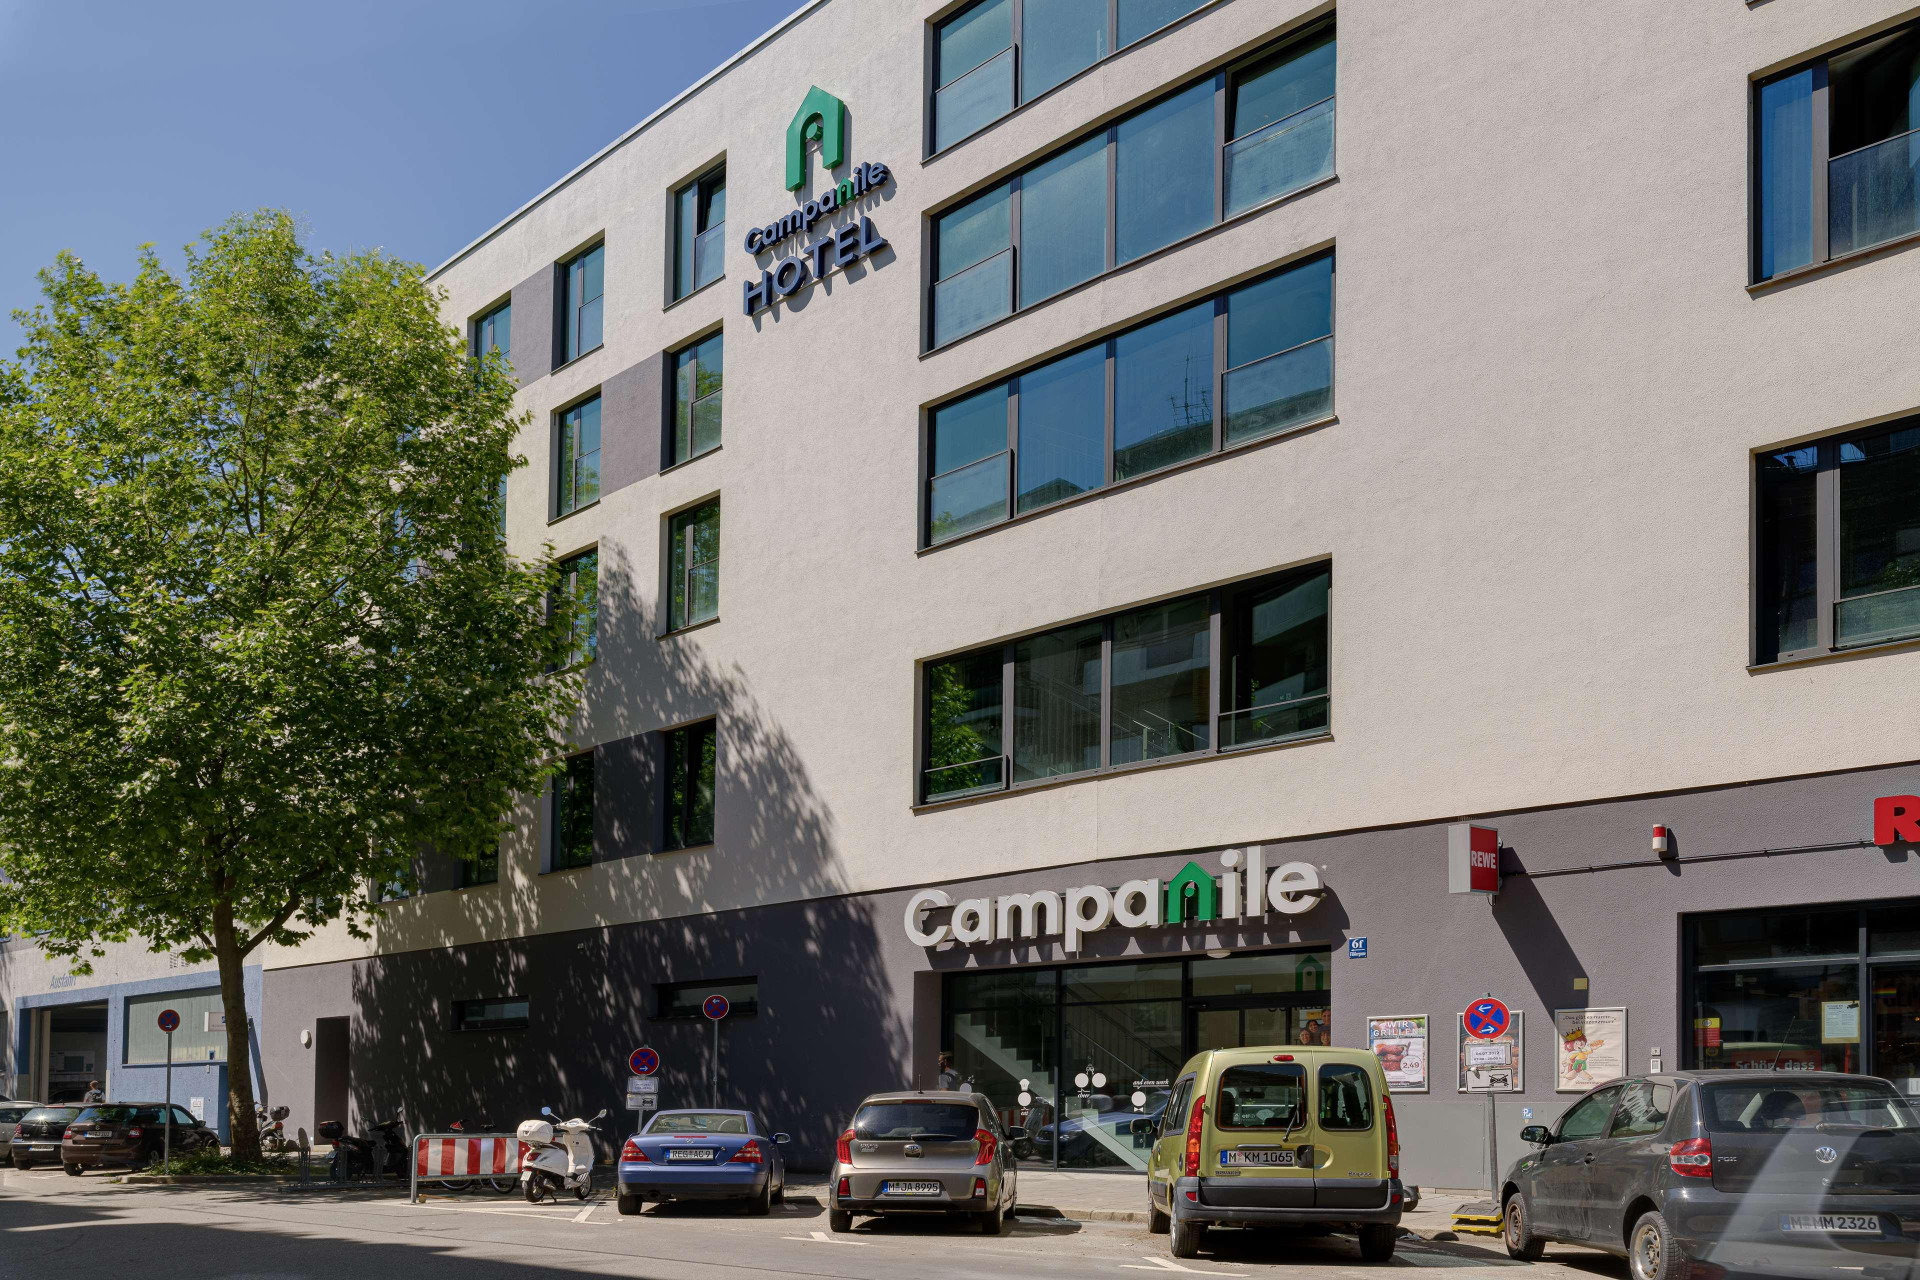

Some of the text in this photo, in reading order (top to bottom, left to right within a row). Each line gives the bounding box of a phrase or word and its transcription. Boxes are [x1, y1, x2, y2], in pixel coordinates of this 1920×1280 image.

[744, 161, 889, 255] Campanile
[743, 216, 888, 316] HOTEL
[1471, 850, 1496, 869] REWE
[903, 845, 1326, 953] Campanile
[1351, 938, 1365, 949] 6f
[1784, 1060, 1815, 1070] dass
[1228, 1152, 1293, 1162] M KM 1065
[888, 1182, 938, 1191] M JA 8995
[1812, 1216, 1835, 1229] MM
[1838, 1216, 1877, 1230] 2326
